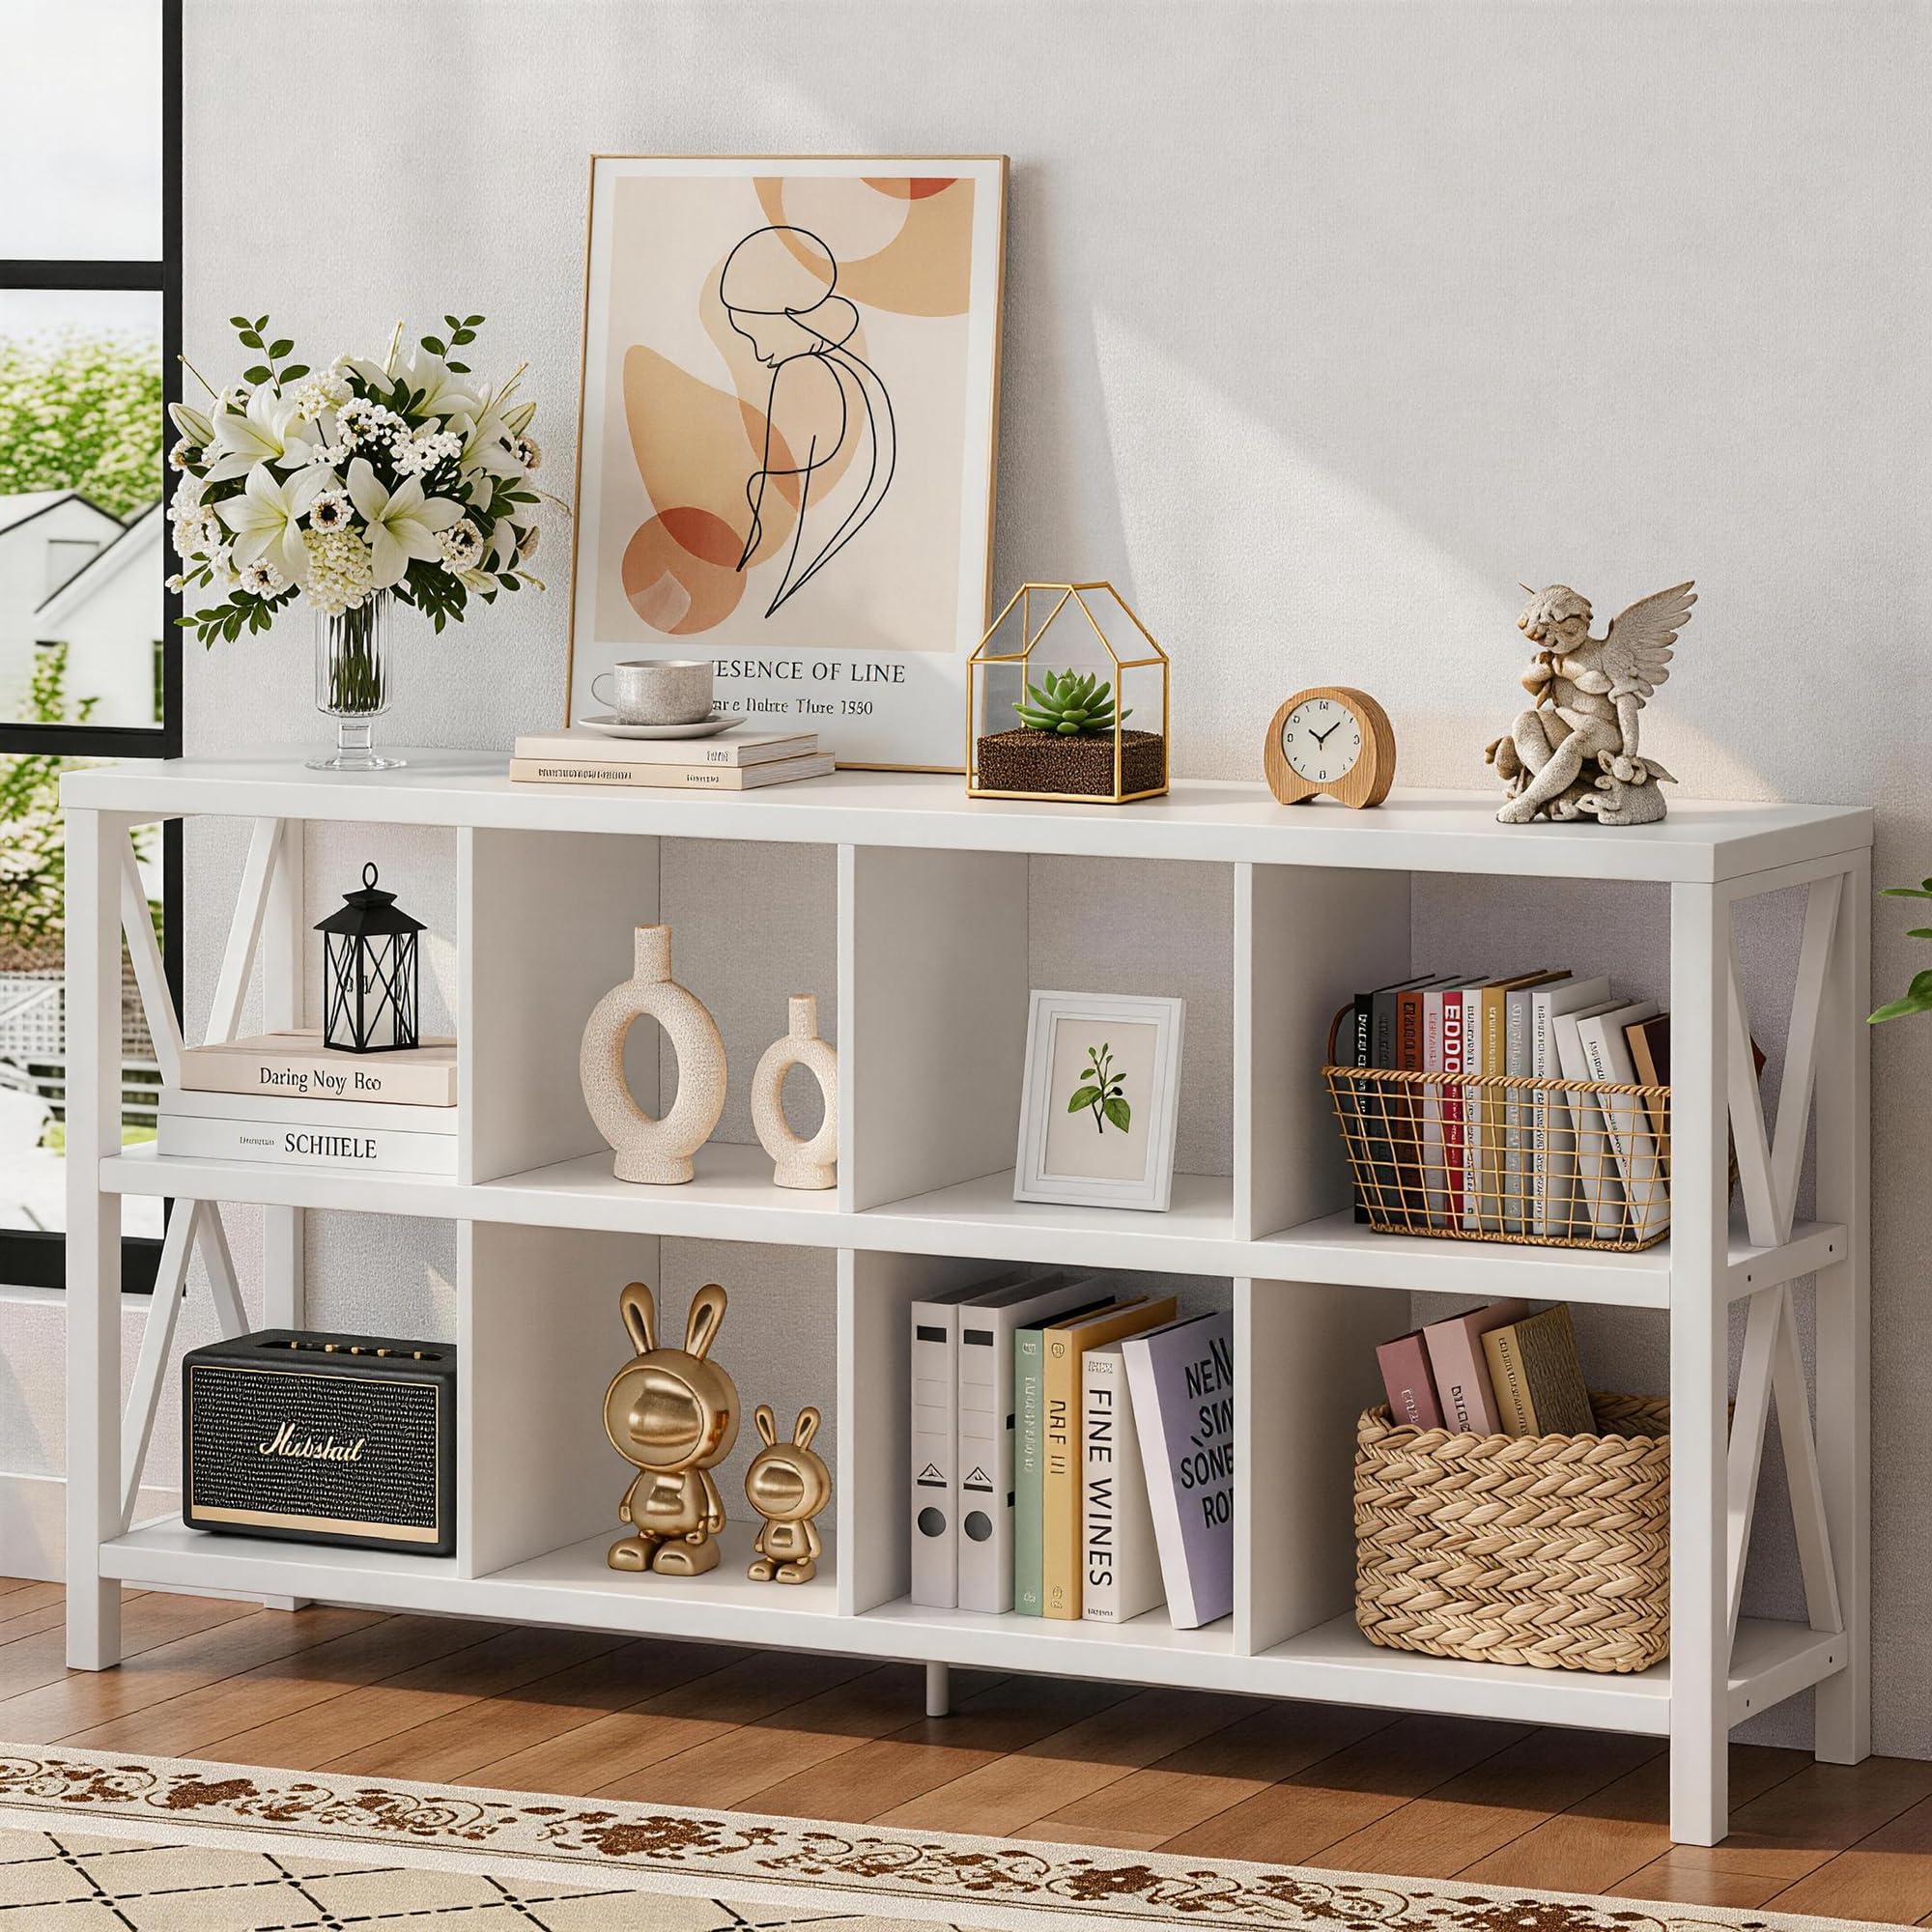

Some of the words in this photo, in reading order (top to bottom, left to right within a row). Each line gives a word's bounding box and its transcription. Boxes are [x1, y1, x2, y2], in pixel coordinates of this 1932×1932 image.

[711, 660, 803, 680] ESENCE
[812, 662, 841, 681] OF
[851, 664, 905, 684] LINE
[260, 1066, 308, 1093] Daring
[1088, 1389, 1112, 1463] FINE
[1088, 1477, 1113, 1586] WINES
